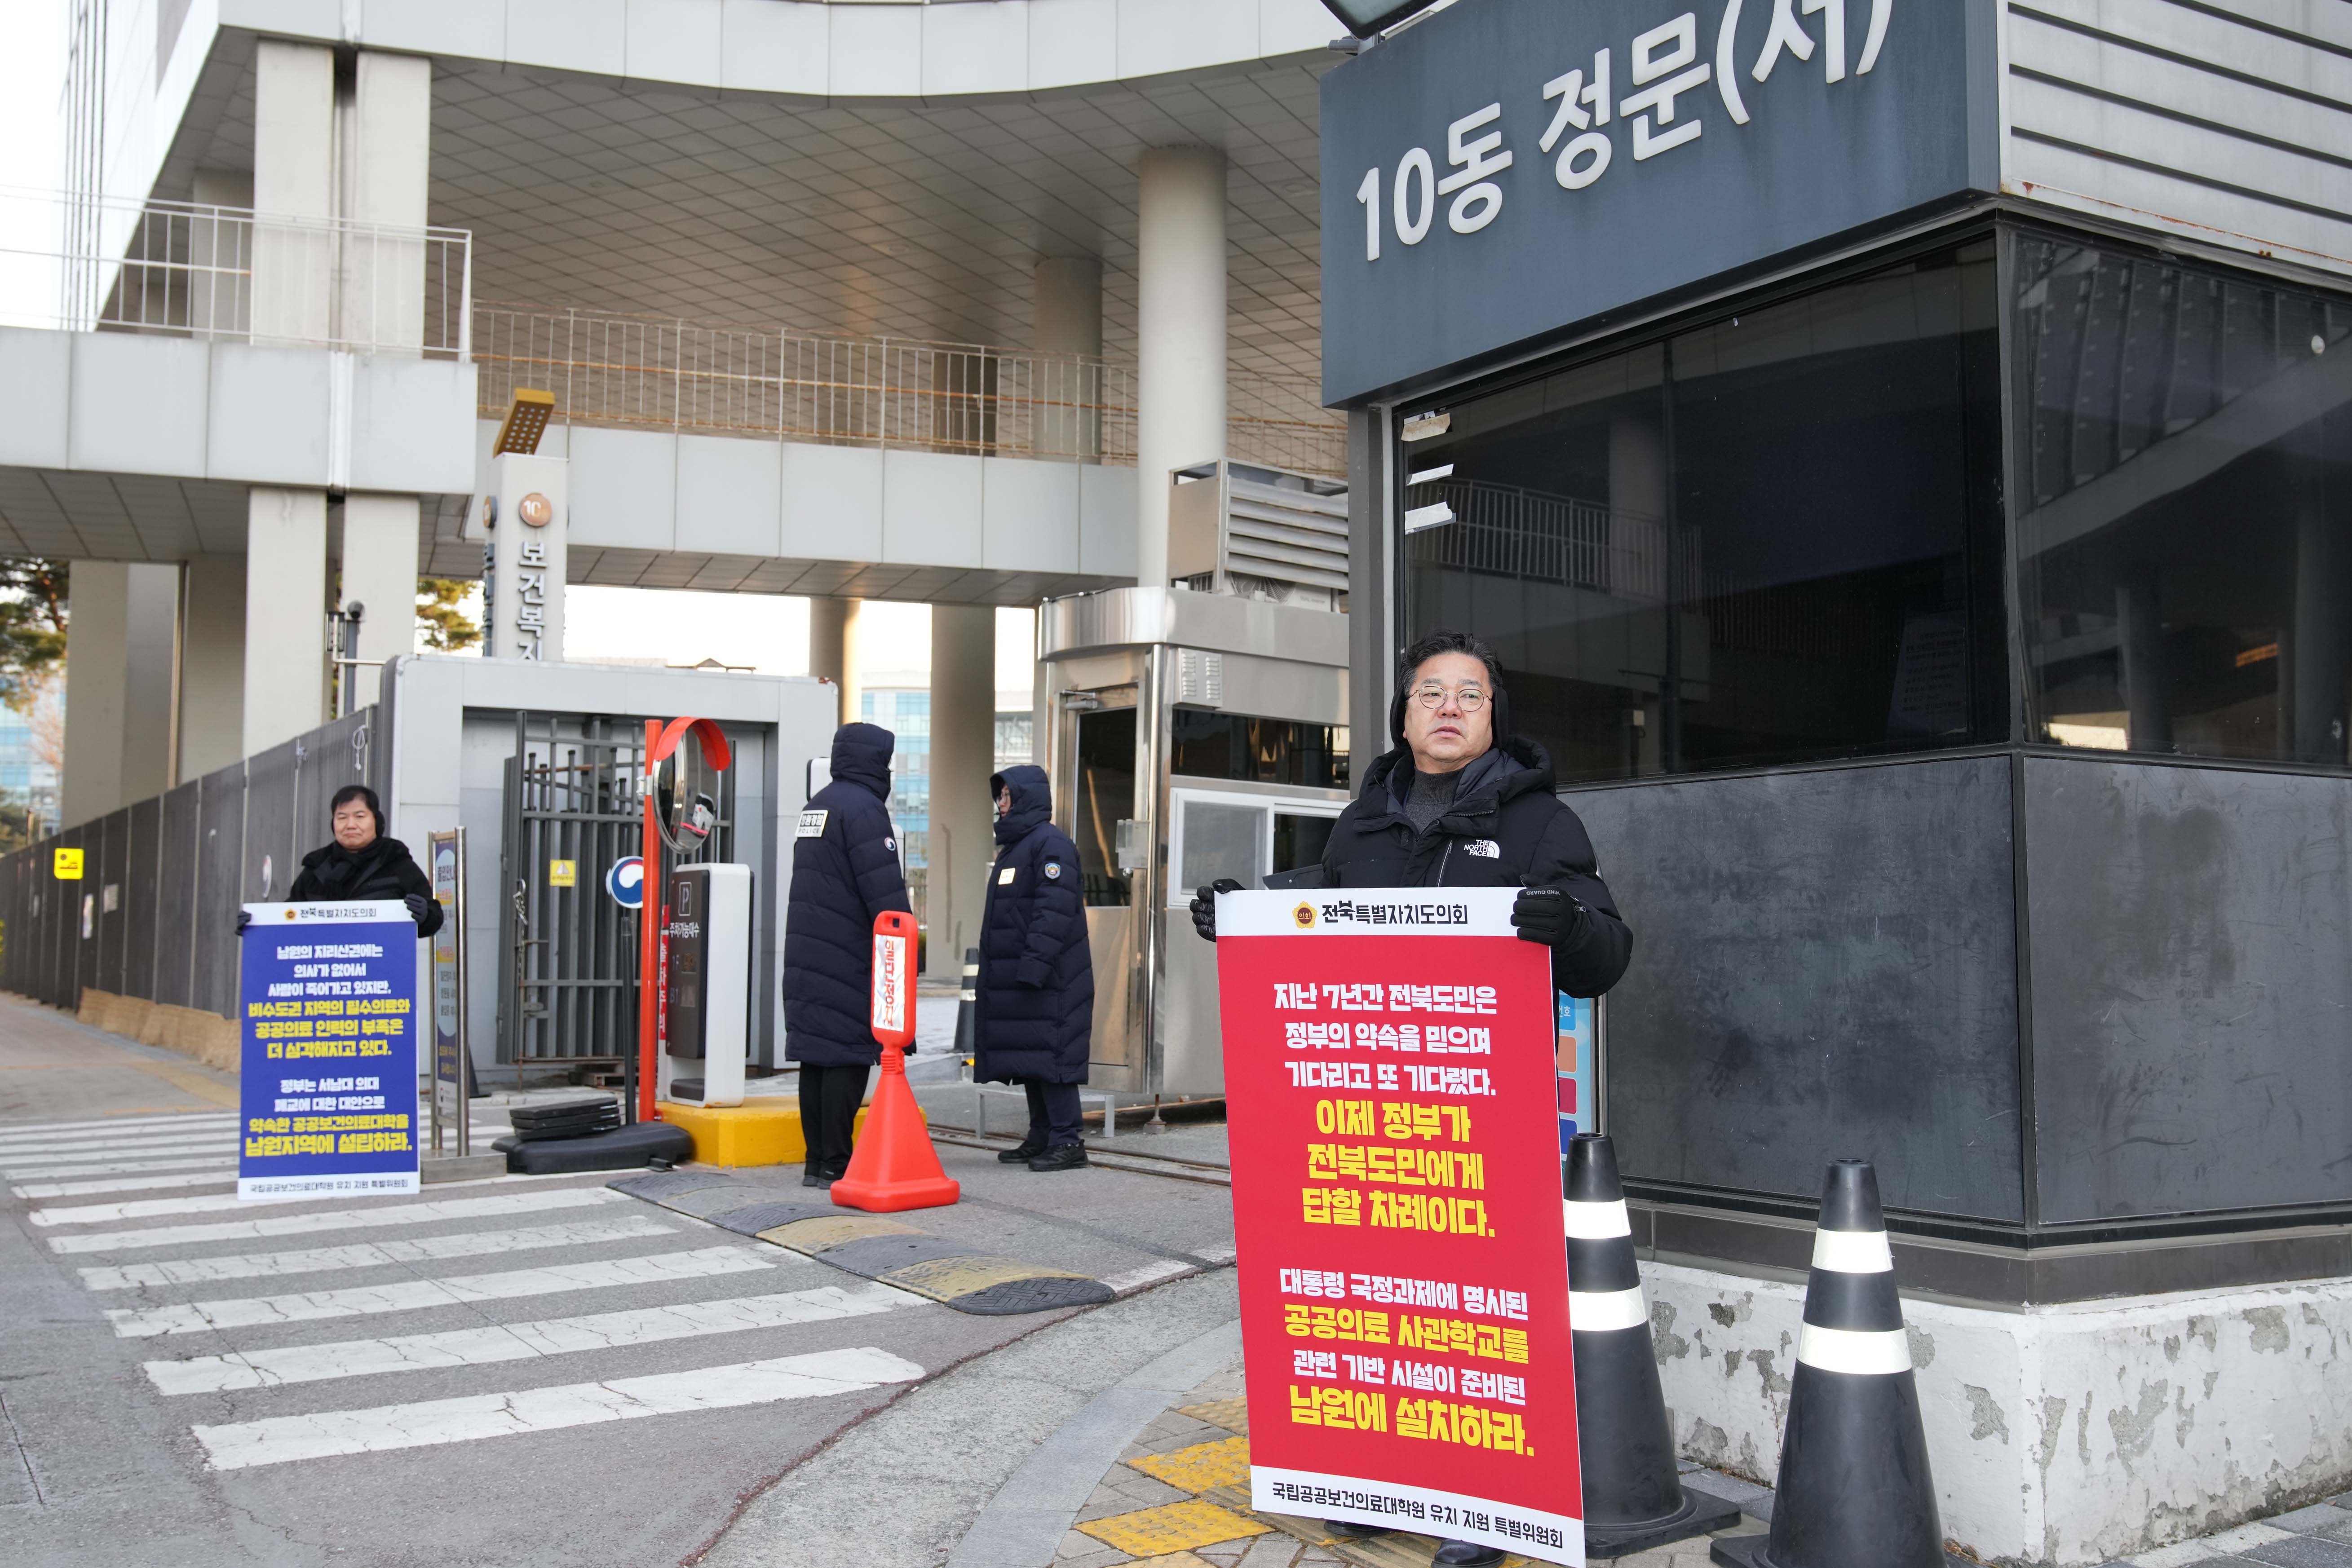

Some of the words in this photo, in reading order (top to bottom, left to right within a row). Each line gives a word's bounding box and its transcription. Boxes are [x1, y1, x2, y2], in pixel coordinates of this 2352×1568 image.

[1357, 102, 1512, 261] 10동
[1539, 0, 1891, 189] 정문(서)
[1298, 912, 1311, 920] 의회
[1322, 901, 1468, 924] 전북특별자치도의회
[1274, 983, 1317, 1009] 지난
[1322, 984, 1384, 1011] 7년간
[1389, 985, 1497, 1014] 전북도민은
[1285, 1022, 1350, 1049] 정부의
[1355, 1023, 1420, 1051] 약속을
[1426, 1026, 1490, 1054] 믿으며
[1285, 1061, 1371, 1089] 기다리고
[1377, 1064, 1398, 1090] 또
[1404, 1065, 1496, 1095] 기다렸다.
[1317, 1100, 1375, 1135] 이제
[1382, 1103, 1471, 1142] 정부가
[1308, 1144, 1484, 1190] 전북도민에게
[1302, 1188, 1361, 1226] 답할
[1369, 1190, 1495, 1237] 차례이다.
[1280, 1268, 1345, 1298] 대통령
[1351, 1274, 1458, 1310] 국정과제에
[1463, 1285, 1528, 1320] 명시된
[1285, 1304, 1390, 1344] 공공의료
[1398, 1315, 1529, 1364] 사관학교를
[1294, 1350, 1337, 1378] 관련
[1342, 1354, 1385, 1384] 기반
[1392, 1360, 1455, 1393] 시설이
[1461, 1369, 1525, 1405] 준비된
[1290, 1385, 1387, 1432] 남원에
[1396, 1397, 1534, 1456] 설치하라.
[1273, 1483, 1424, 1519] 국립공공보건의료대학원
[1431, 1505, 1457, 1525] 유치
[1463, 1510, 1489, 1532] 지원
[1495, 1517, 1562, 1548] 특별위원회
